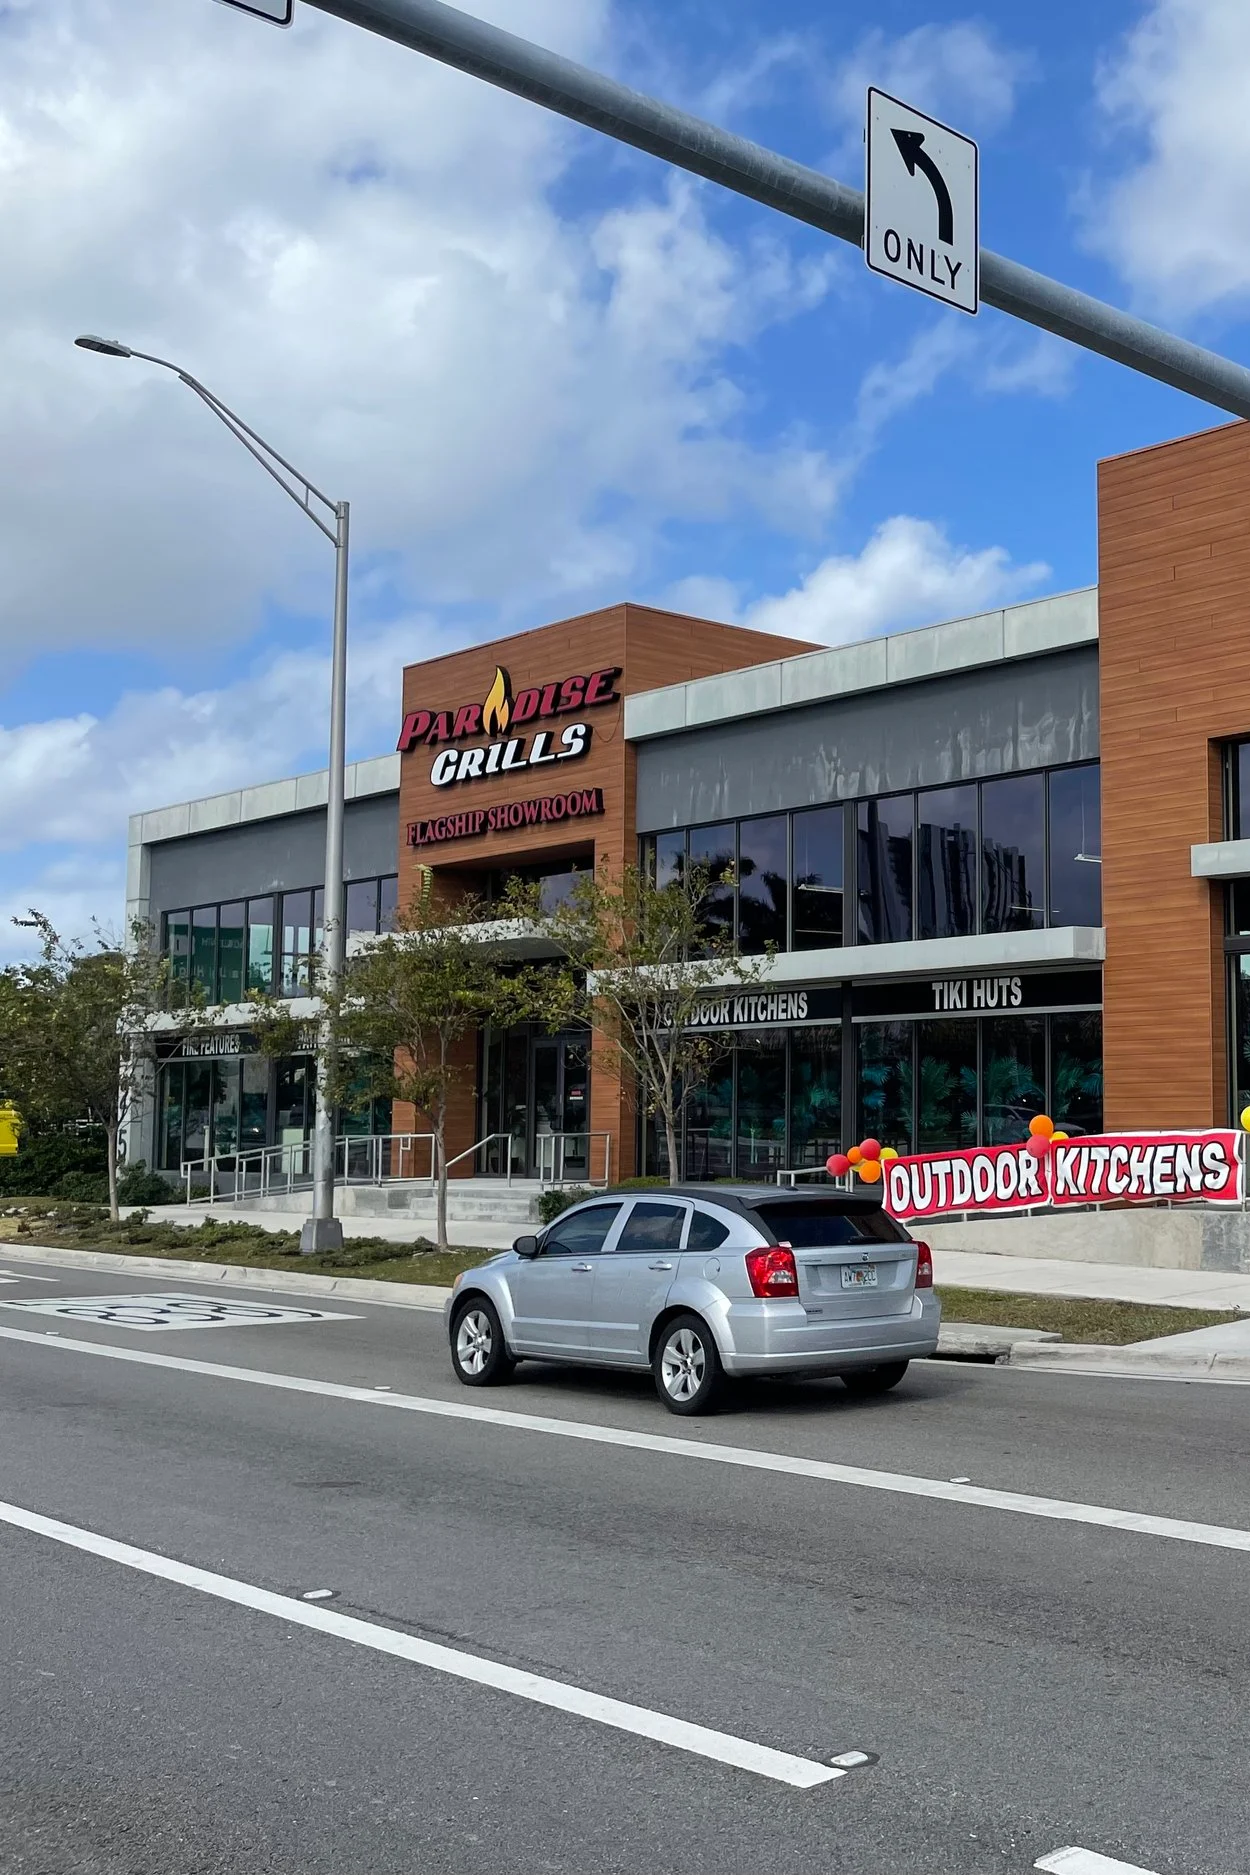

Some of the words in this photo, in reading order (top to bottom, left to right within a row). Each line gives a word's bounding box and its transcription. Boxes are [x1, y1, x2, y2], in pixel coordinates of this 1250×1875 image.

[883, 228, 963, 290] ONLY
[430, 722, 594, 787] GRILLS
[406, 809, 489, 846] FLAGSHIP
[488, 787, 606, 832] SHOWROOM
[733, 991, 808, 1023] KITCHENS
[931, 980, 967, 1011] TIKI
[973, 976, 1022, 1008] HUTS
[199, 1033, 241, 1056] FEATURES
[890, 1148, 1044, 1214] OUTDOOR
[1055, 1141, 1231, 1196] KITCHENS
